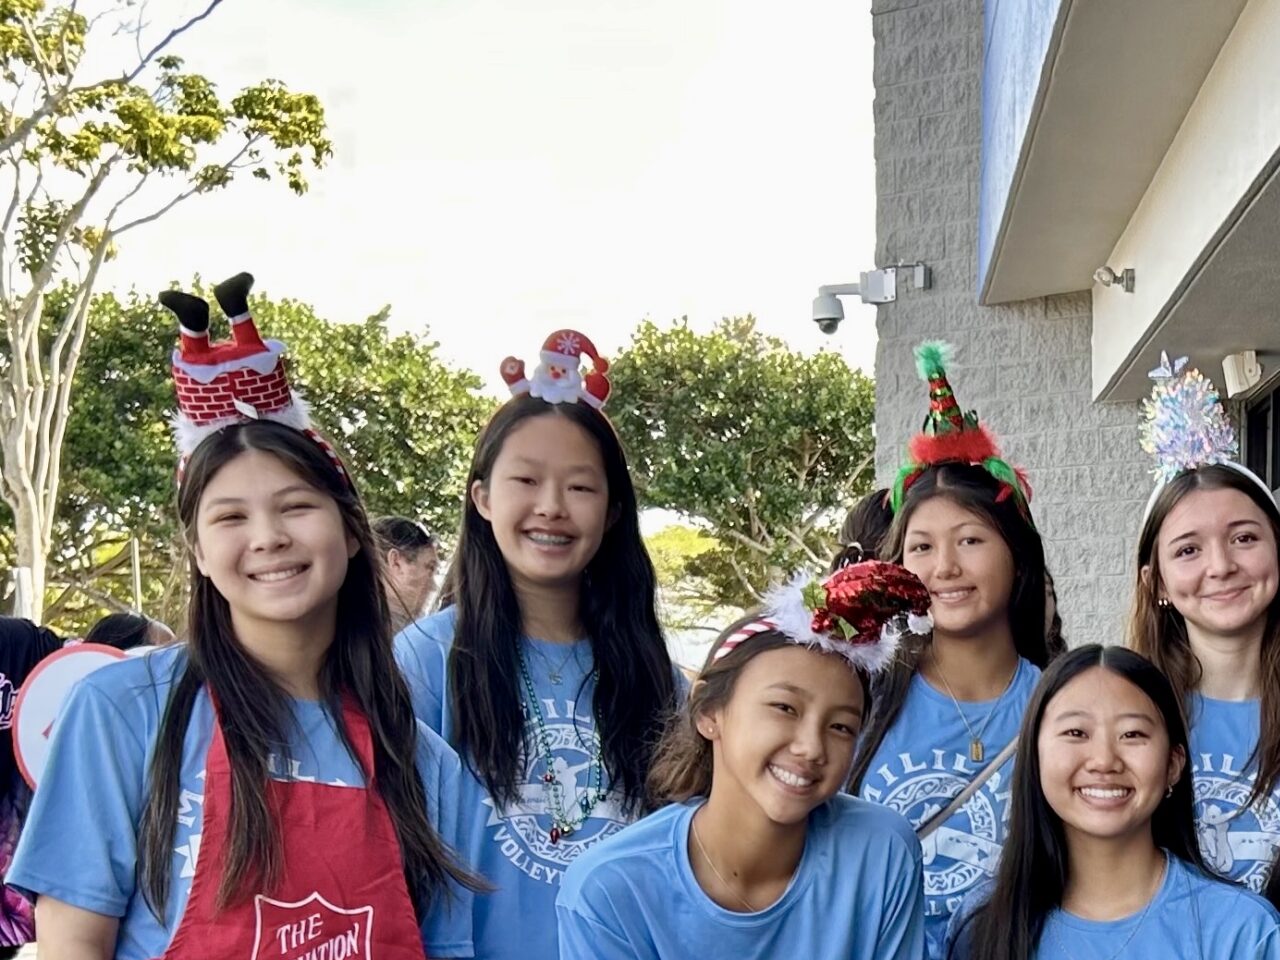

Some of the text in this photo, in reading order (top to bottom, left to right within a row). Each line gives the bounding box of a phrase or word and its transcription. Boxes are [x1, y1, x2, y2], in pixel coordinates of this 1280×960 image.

[863, 749, 1012, 839] ILILN
[493, 826, 568, 886] VOLLEY
[277, 913, 323, 954] THE
